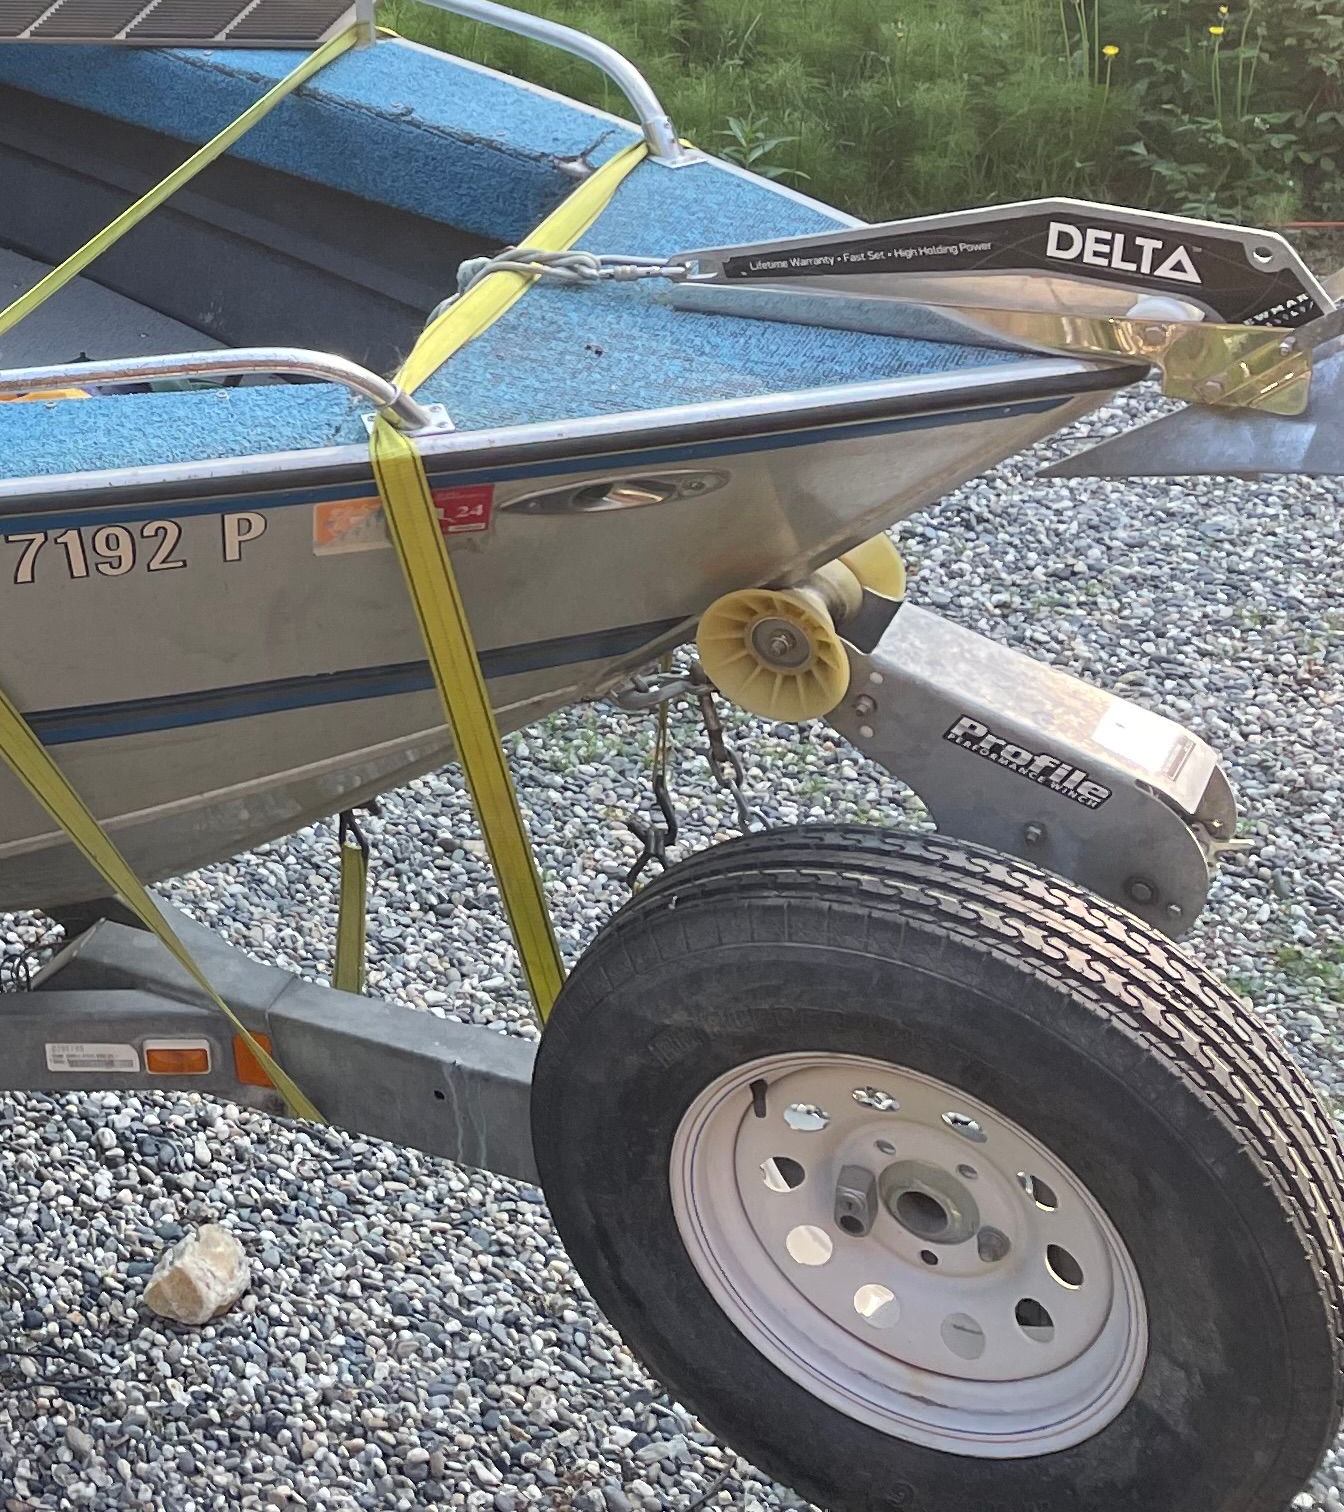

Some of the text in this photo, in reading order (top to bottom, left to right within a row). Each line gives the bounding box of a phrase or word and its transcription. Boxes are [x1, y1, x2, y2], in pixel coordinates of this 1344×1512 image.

[749, 242, 992, 271] Lifetime Warranty Fast Set High Holding Power
[1046, 221, 1202, 284] DELTA
[4, 519, 187, 584] 7192
[221, 511, 267, 562] P
[947, 732, 1099, 809] PERFORMANCE WINCH
[950, 716, 1111, 802] Profile
